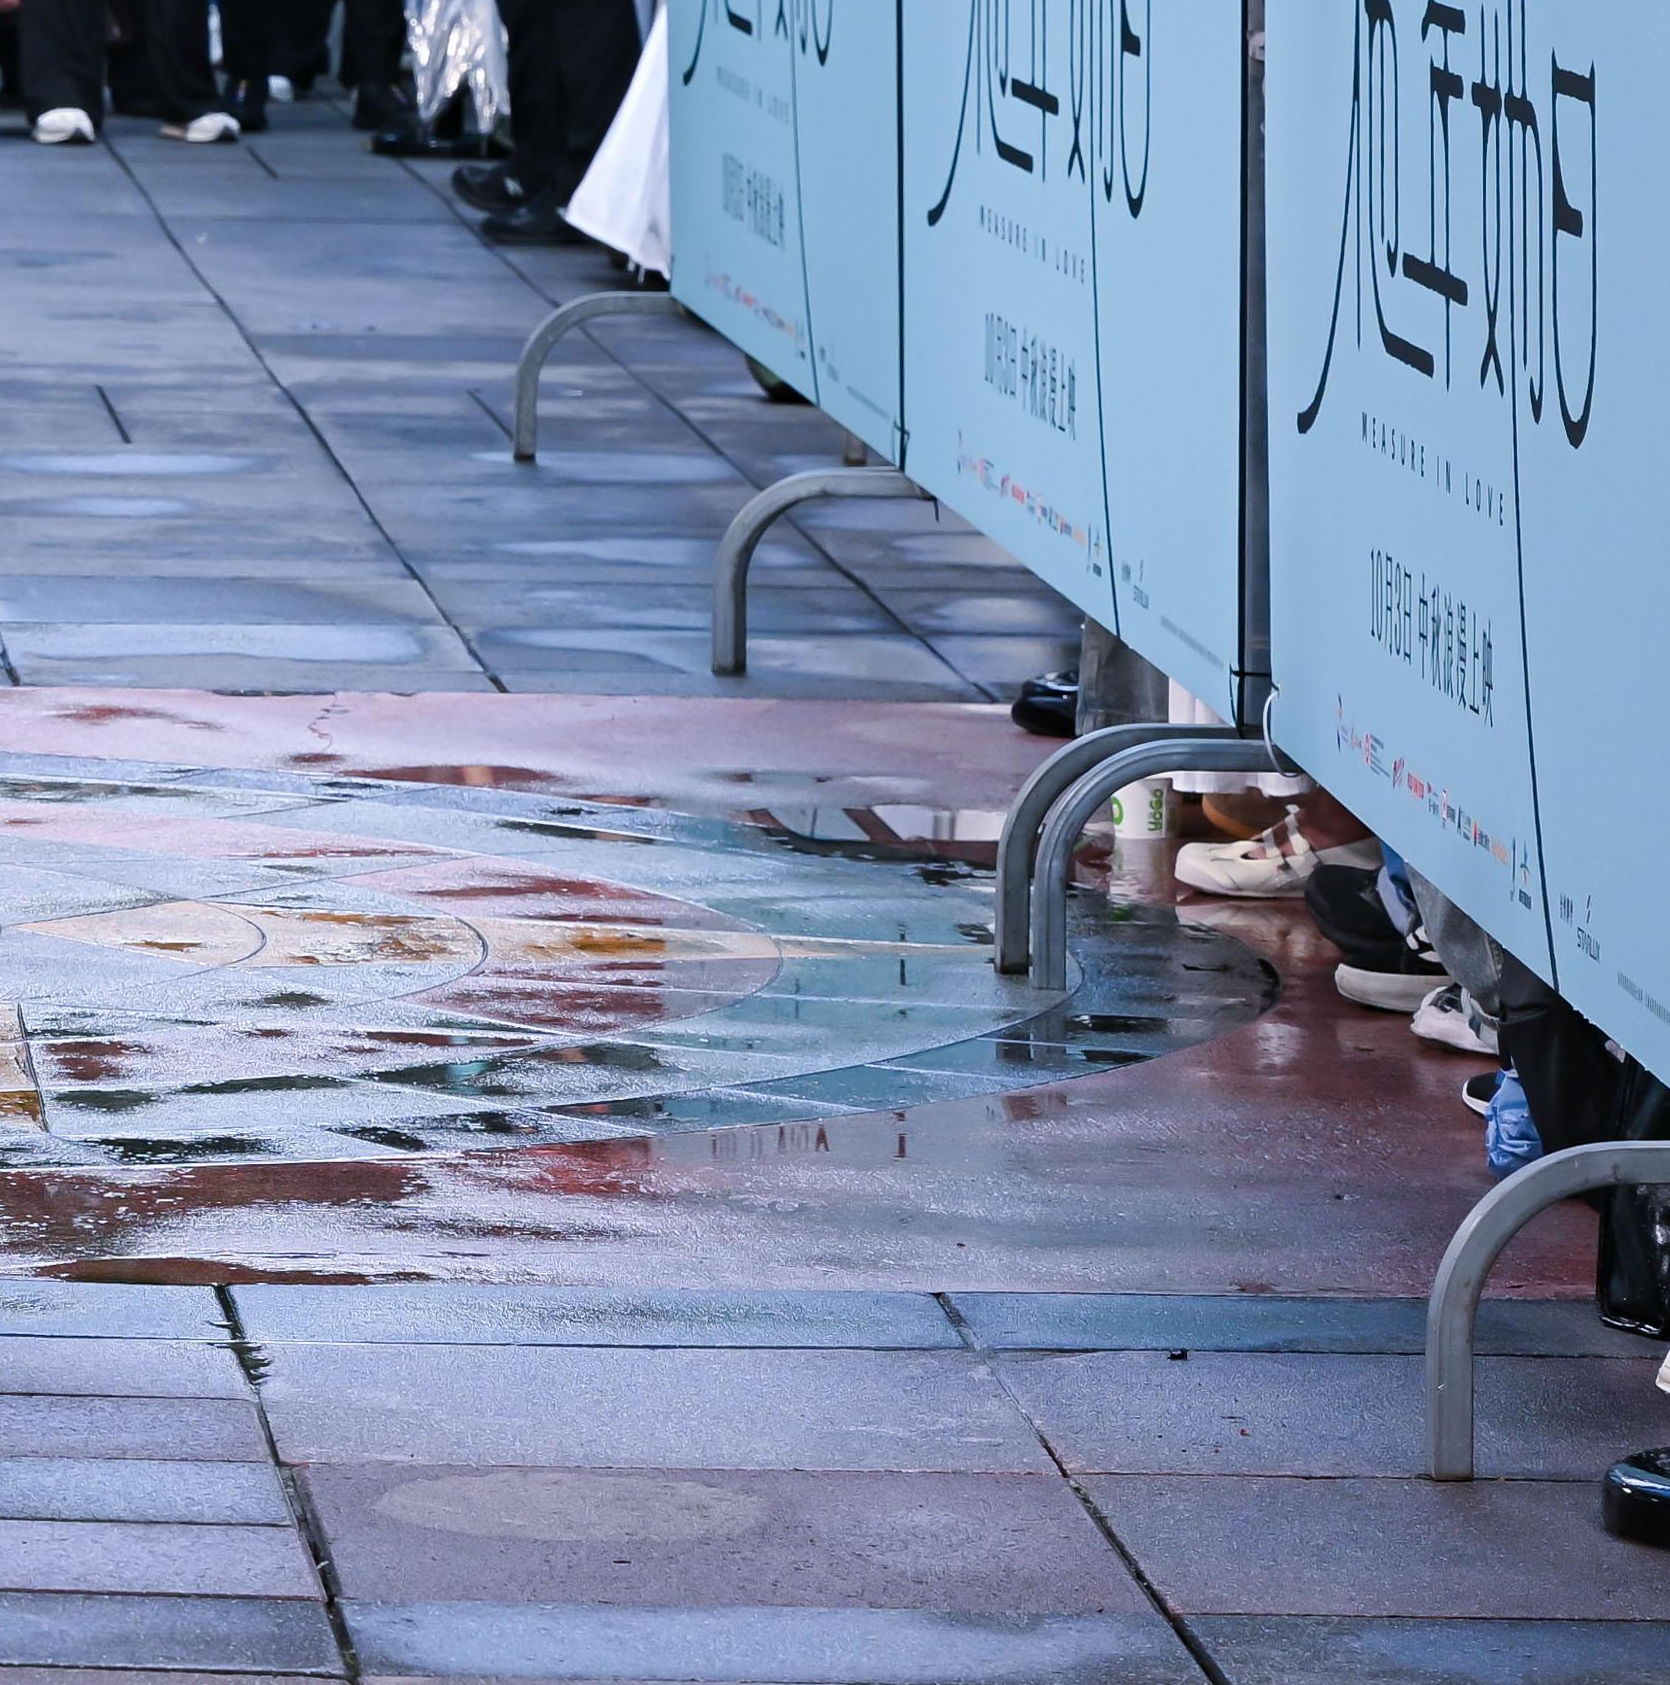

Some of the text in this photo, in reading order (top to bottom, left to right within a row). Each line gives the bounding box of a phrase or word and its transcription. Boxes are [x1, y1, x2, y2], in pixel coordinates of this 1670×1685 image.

[1362, 411, 1504, 527] MEASURE IN LOVE
